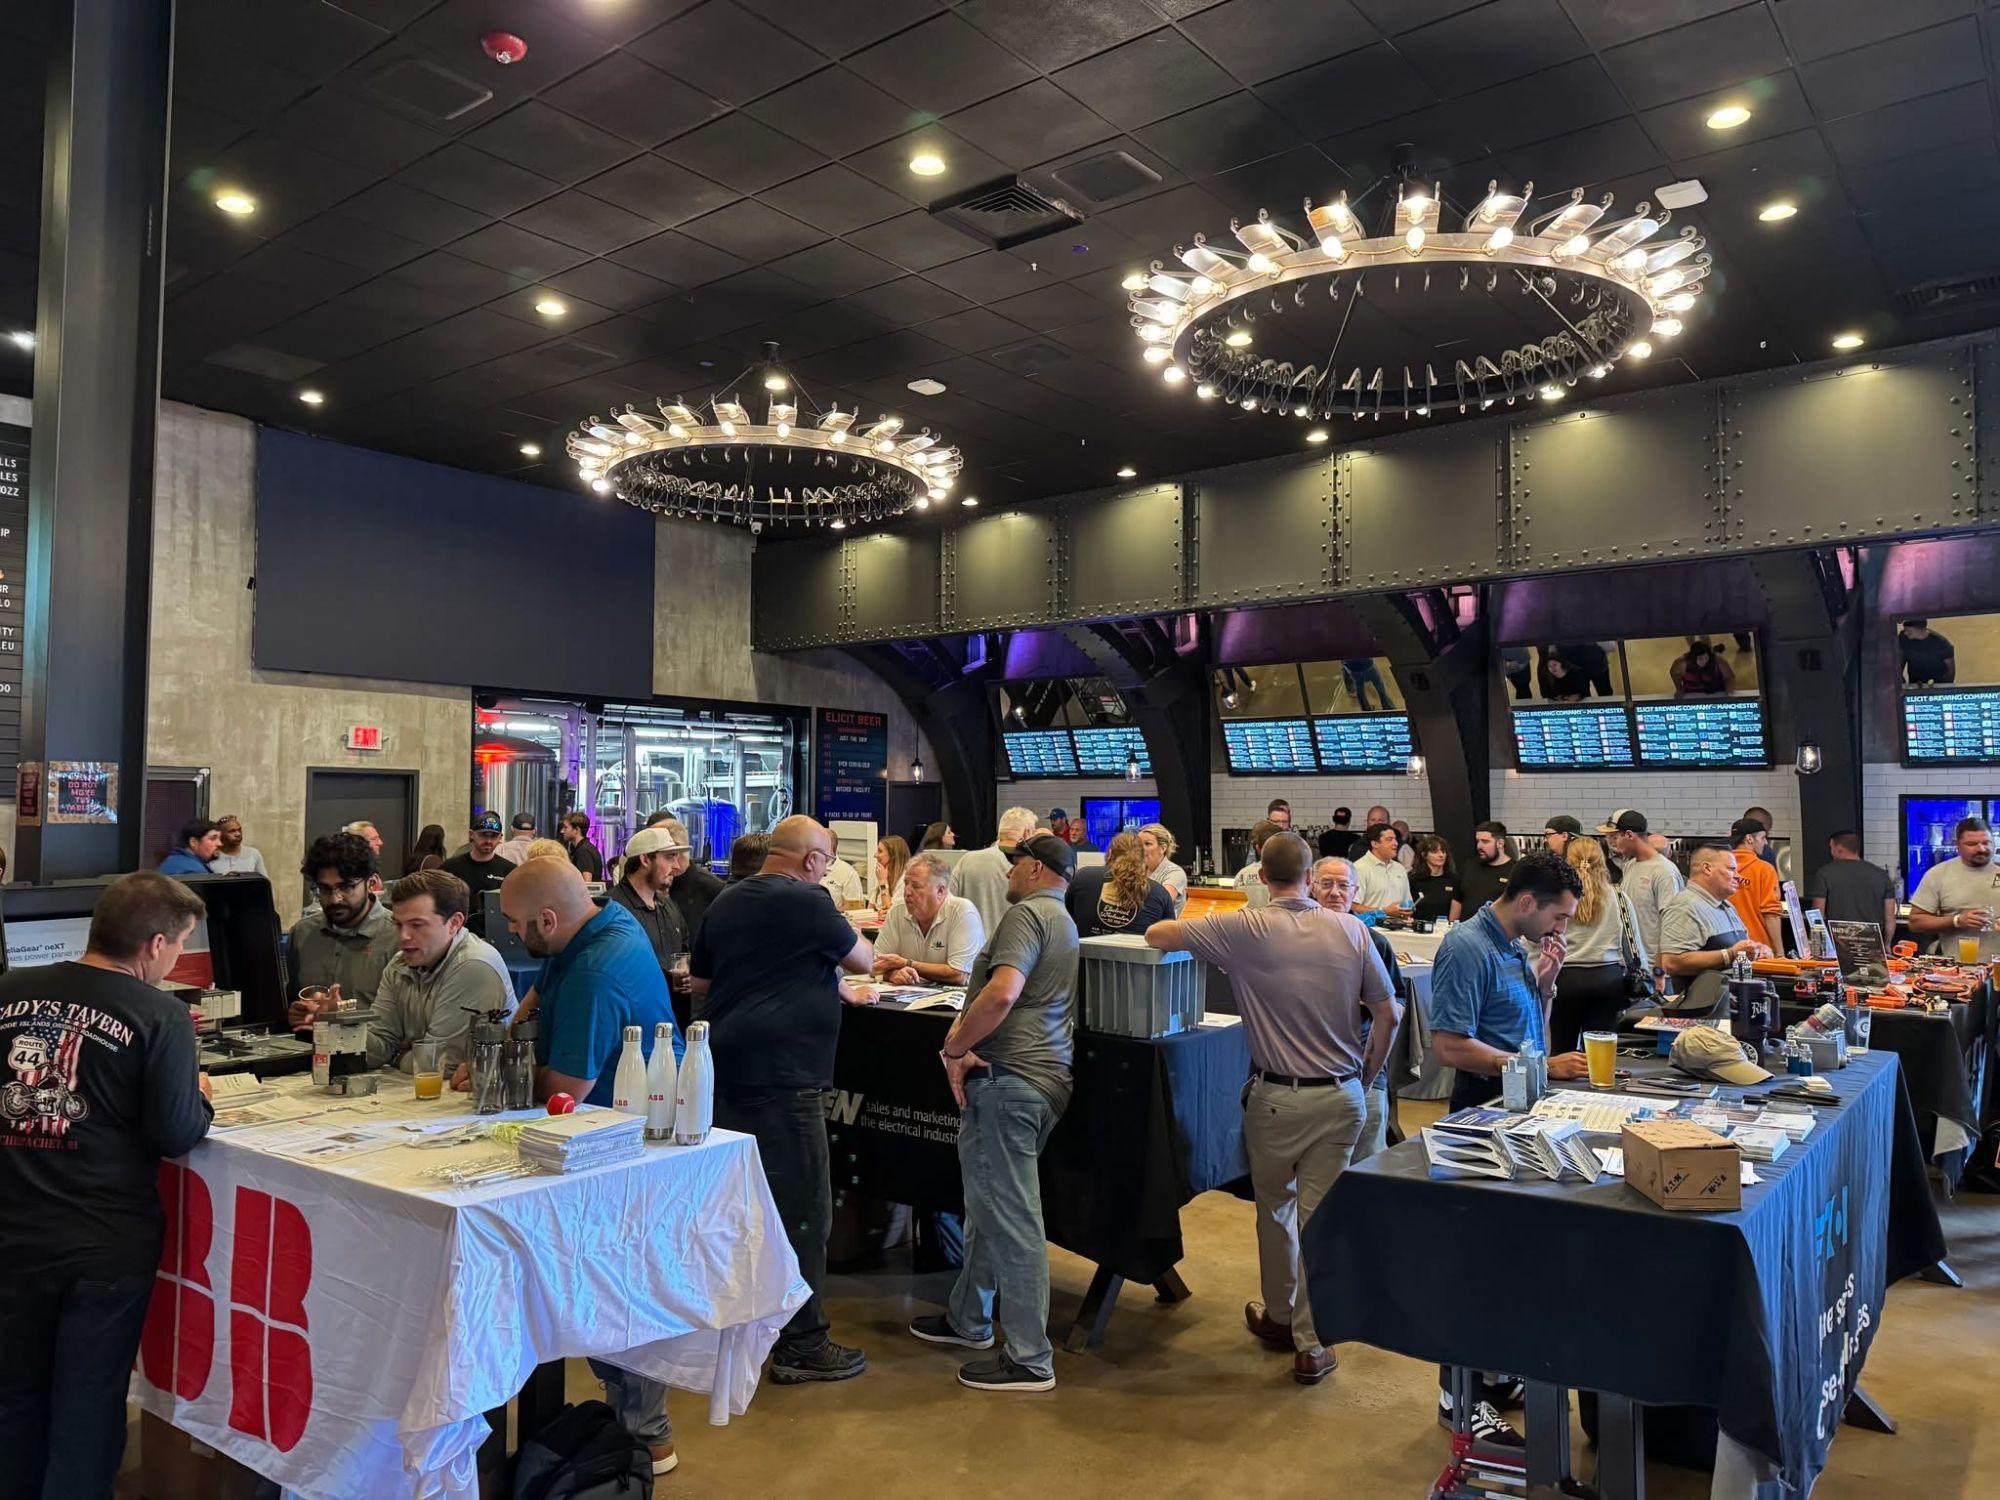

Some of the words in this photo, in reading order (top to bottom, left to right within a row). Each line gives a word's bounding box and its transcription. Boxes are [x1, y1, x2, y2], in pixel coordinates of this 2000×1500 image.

[0, 485, 20, 497] OZZ
[1963, 692, 1999, 700] COMPANY
[825, 711, 854, 724] ELICIT
[857, 715, 881, 727] BEER
[70, 788, 96, 797] MOVE
[0, 999, 62, 1020] ADY'S
[66, 1002, 135, 1048] TAVERN
[18, 1039, 44, 1049] ROUTE
[81, 1028, 119, 1053] ROADHOUSE
[14, 1050, 40, 1066] 44
[614, 1098, 628, 1107] ABB
[865, 1101, 890, 1115] sales
[892, 1105, 911, 1119] and
[860, 1114, 876, 1129] the
[878, 1118, 921, 1137] electrical
[923, 1125, 960, 1144] industr
[134, 1160, 314, 1453] BB
